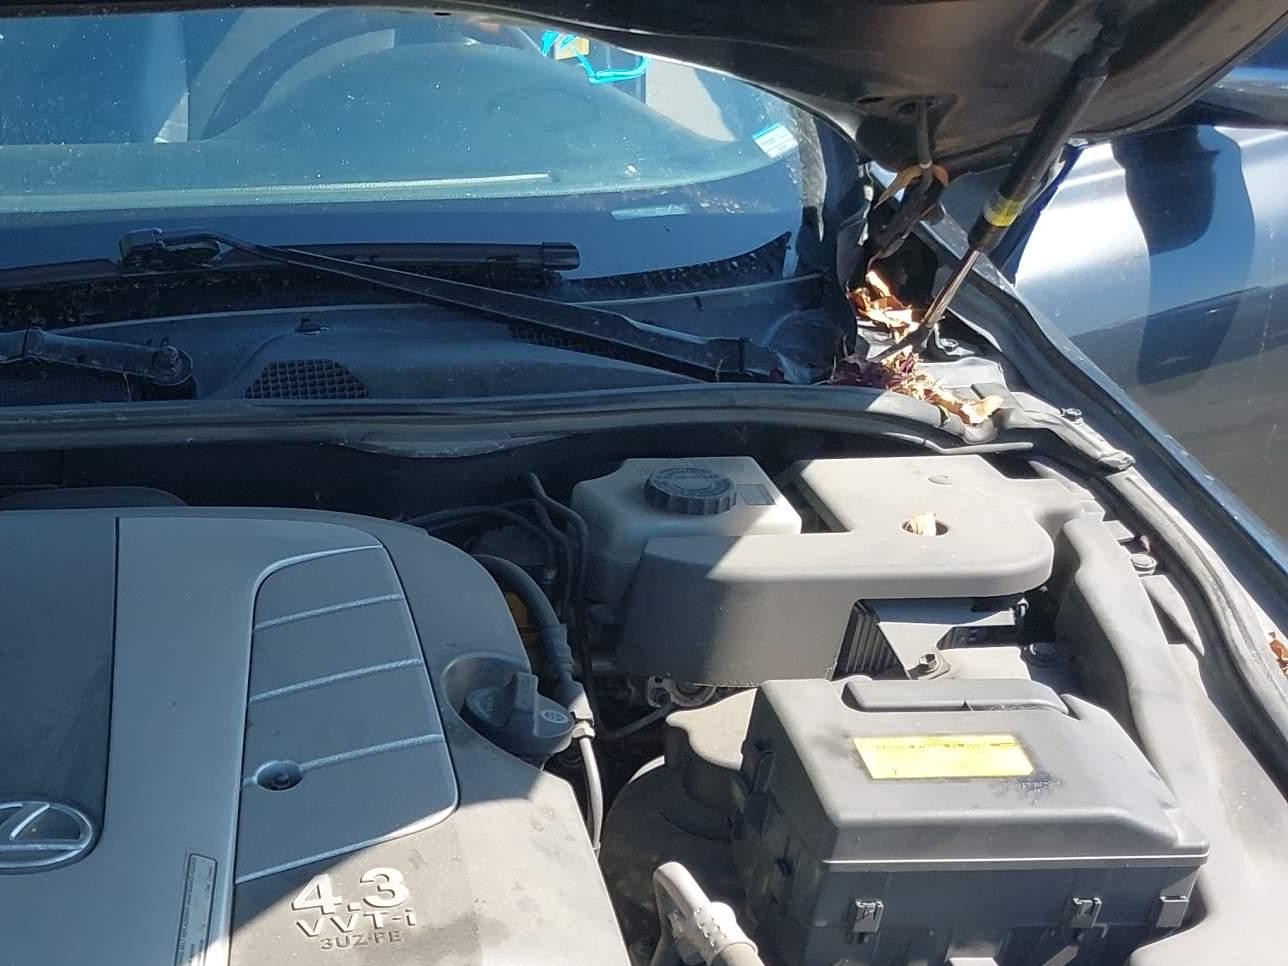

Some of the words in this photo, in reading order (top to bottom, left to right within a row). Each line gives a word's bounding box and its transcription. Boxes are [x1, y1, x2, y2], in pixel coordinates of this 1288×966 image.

[290, 867, 410, 915] 4.3
[295, 908, 417, 938] VVT-i
[320, 930, 403, 951] 3UZ-FE
